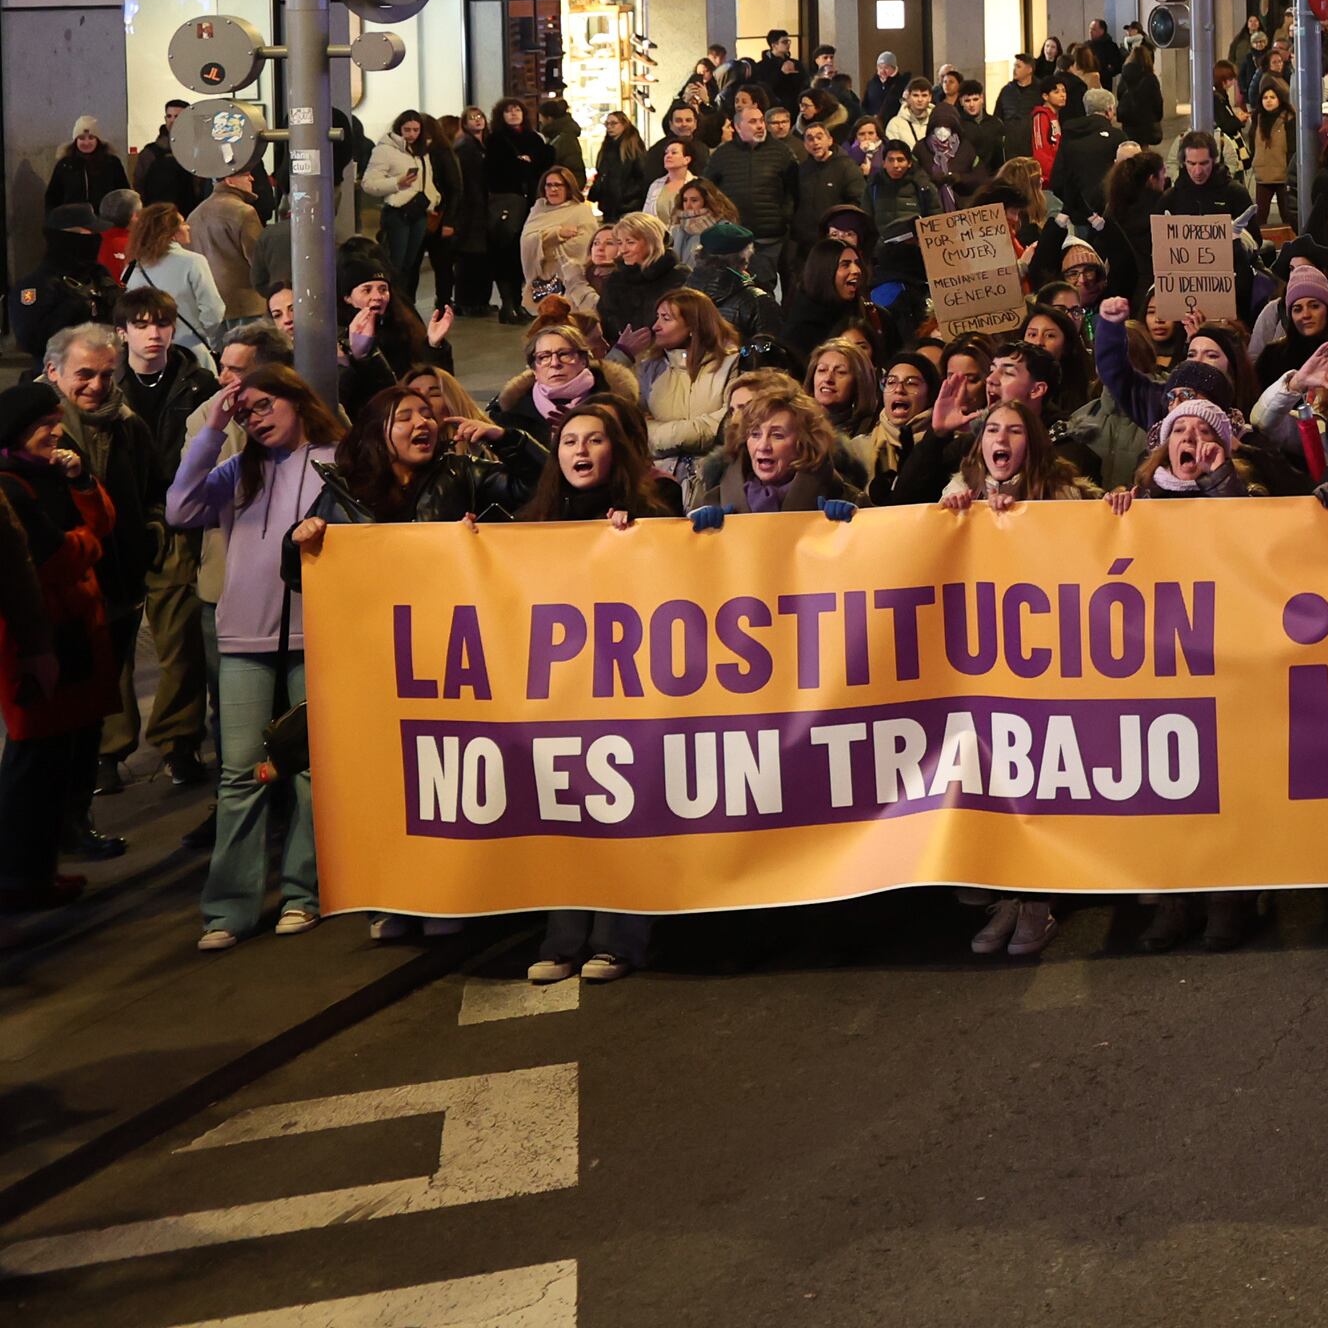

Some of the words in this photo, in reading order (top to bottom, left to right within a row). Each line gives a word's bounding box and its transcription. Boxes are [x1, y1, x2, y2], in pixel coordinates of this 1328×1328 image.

[919, 219, 940, 234] ME
[946, 208, 1000, 229] OPRIMEN
[1167, 224, 1179, 240] MI
[1182, 221, 1227, 240] OPRESIÓN
[925, 234, 954, 249] POR
[960, 229, 975, 242] MI
[979, 224, 1007, 238] SEXO
[942, 239, 997, 266] (MUJER)
[1169, 247, 1190, 264] NO
[1198, 246, 1216, 264] ES
[933, 271, 989, 289] MEDIANTE
[997, 267, 1012, 276] EL
[1157, 272, 1175, 293] TÚ
[1179, 275, 1233, 293] IDENTIDAD
[948, 308, 1021, 337] (FEMINIDAD)
[393, 604, 493, 701] LA
[525, 558, 1216, 700] PROSTITUCIÓN
[415, 734, 508, 826] NO
[532, 734, 635, 825] ES
[663, 729, 783, 820] UN
[810, 711, 1200, 810] TRABAJO
